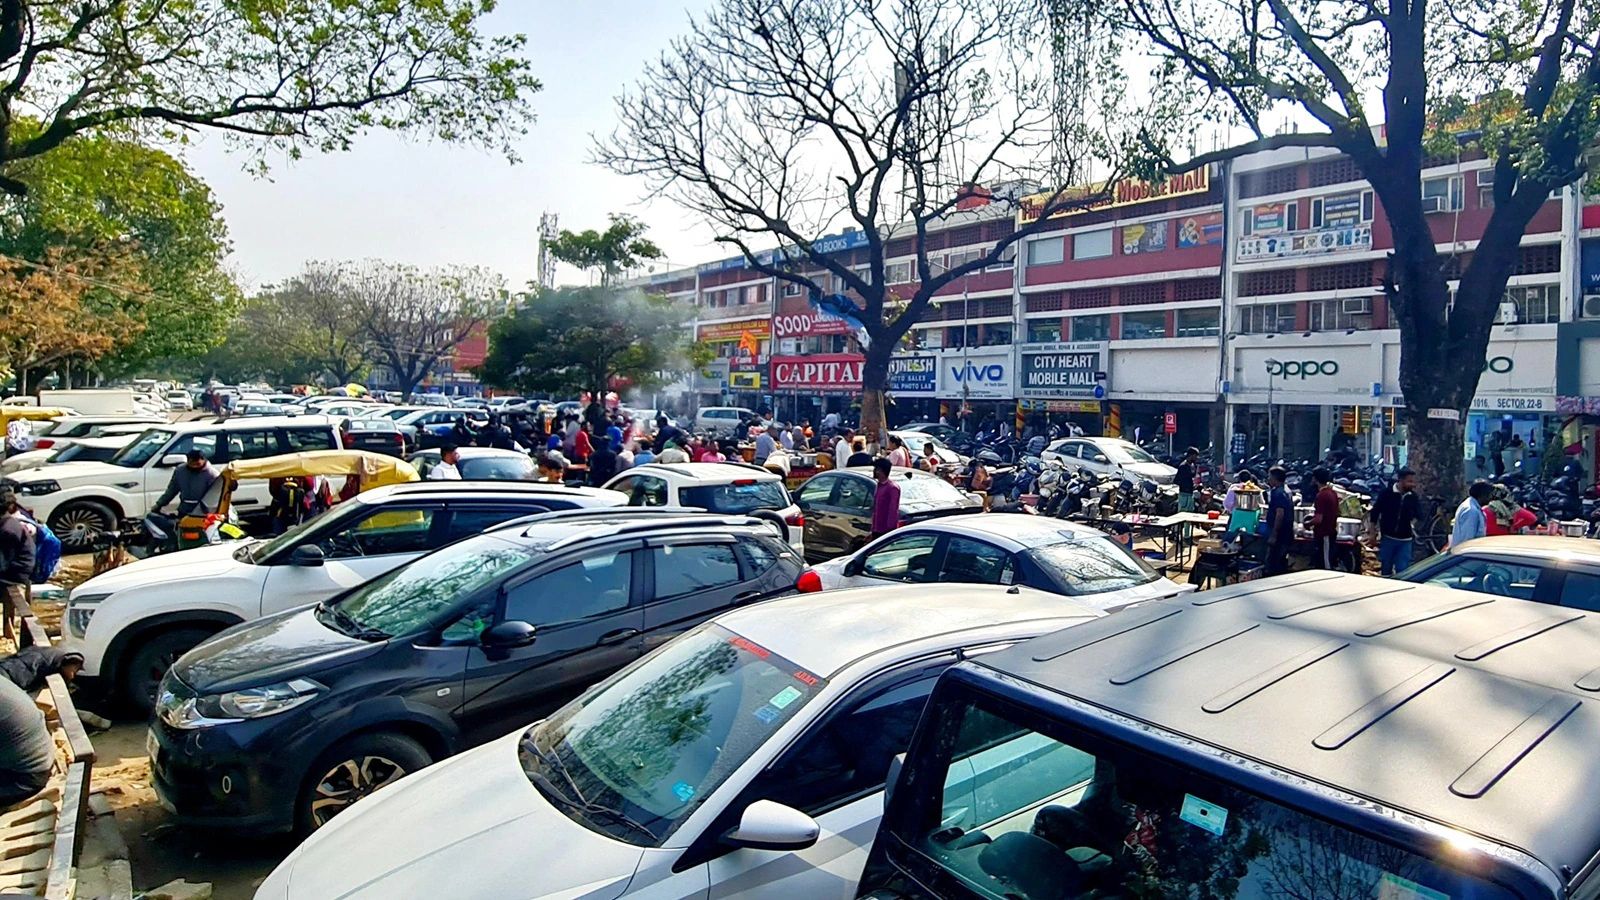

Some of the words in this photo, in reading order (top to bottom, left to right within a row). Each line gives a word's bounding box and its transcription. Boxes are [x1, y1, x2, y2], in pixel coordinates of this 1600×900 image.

[823, 238, 847, 253] BOOKS
[774, 315, 811, 336] SOOD
[1034, 356, 1056, 368] CITY
[1058, 355, 1093, 368] HEART
[951, 360, 1004, 382] vivo
[1266, 360, 1338, 380] oppo
[1028, 372, 1067, 385] MOBILE
[1069, 371, 1098, 385] MALL
[920, 382, 932, 390] LAB
[1497, 398, 1525, 408] SECTOR
[1527, 399, 1542, 409] 22-B
